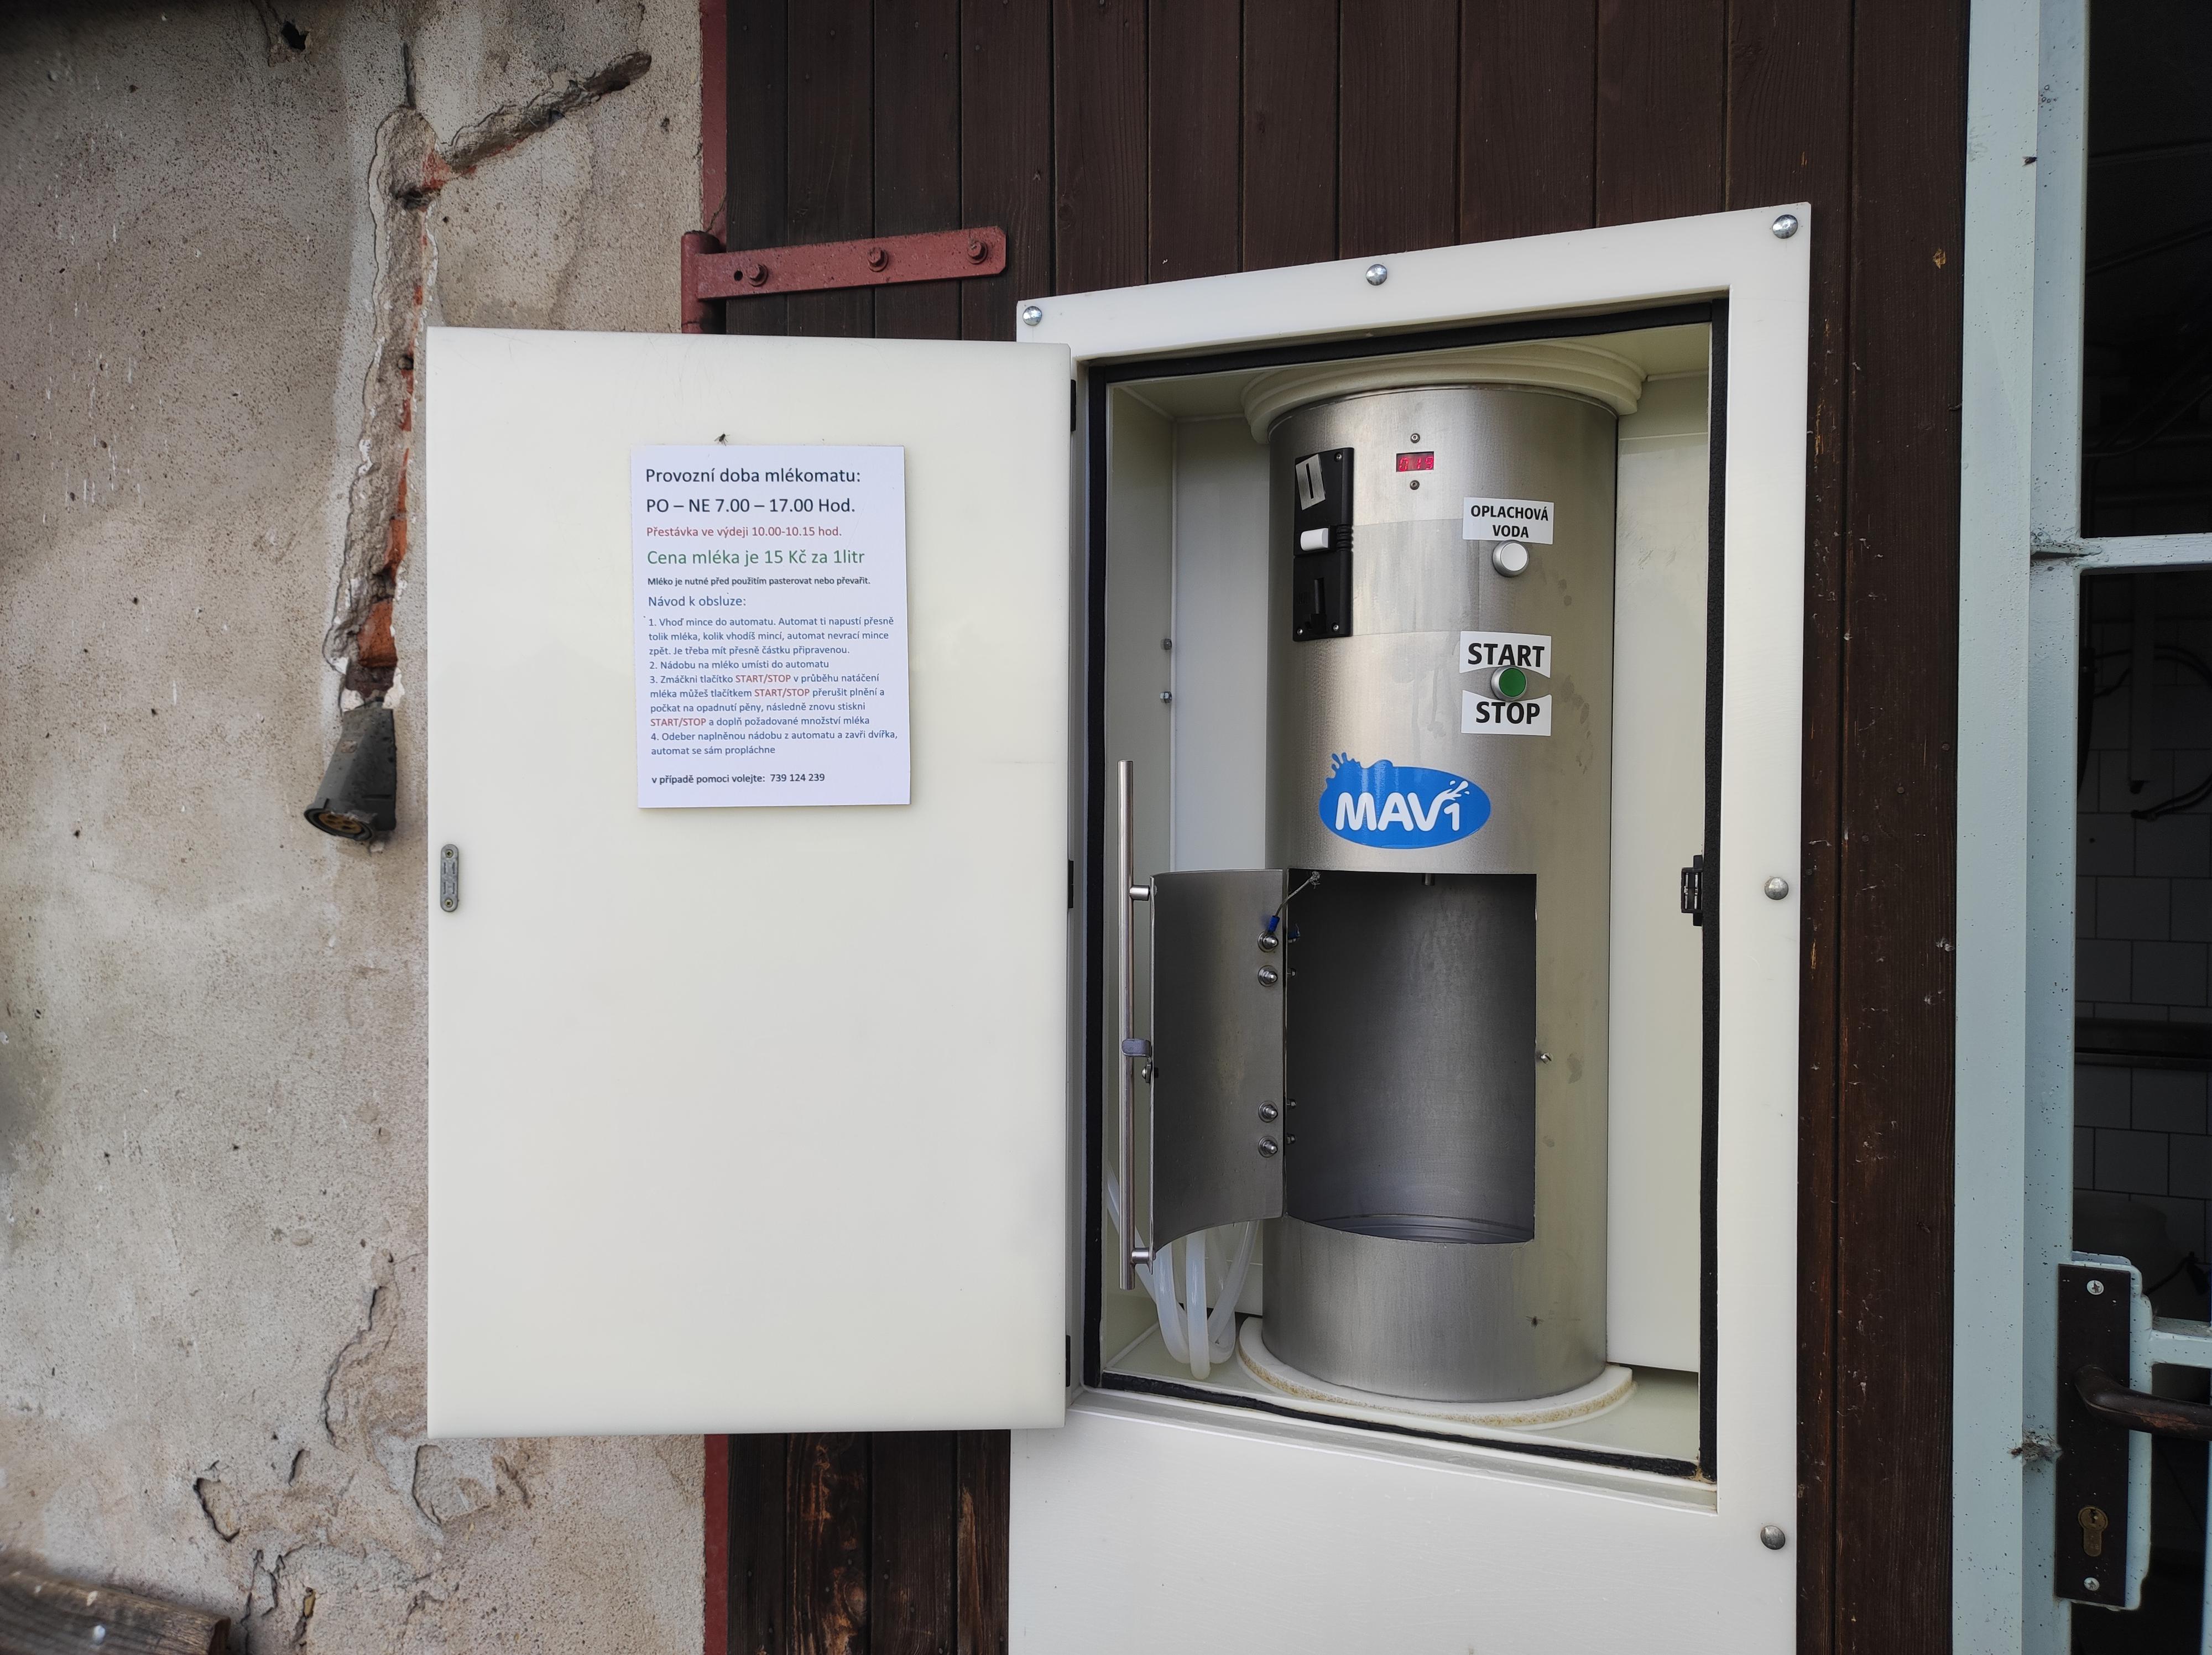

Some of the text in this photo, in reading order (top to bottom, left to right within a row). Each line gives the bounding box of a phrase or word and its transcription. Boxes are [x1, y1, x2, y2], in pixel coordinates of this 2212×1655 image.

[646, 467, 860, 483] Provozní doba mlékomatu:
[646, 498, 669, 513] PO
[688, 498, 711, 513] NE
[714, 498, 750, 513] 7.00
[769, 498, 814, 513] 17.00
[818, 497, 855, 513] Hod.
[1470, 505, 1549, 521] OPLACHOVÁ
[646, 525, 843, 539] Přestávka ve výdeji 10.00-10.15 hod.
[1492, 524, 1530, 538] VODA
[647, 549, 865, 567] Cena mléka je 15 Kč za 1litr
[647, 576, 871, 587] Mléko je nutné před použitím pasterovat nebo převařit.
[648, 595, 746, 607] Návod k obsluze:
[648, 616, 894, 628] 1. Vhoď mince do automatu. Automat ti napustí přesně
[648, 632, 669, 641] tolik
[670, 631, 701, 642] mléka,
[703, 631, 724, 640] kolik
[726, 631, 756, 640] vhodíš
[758, 631, 785, 641] mincí,
[827, 630, 860, 640] nevrací
[862, 630, 889, 640] mince
[649, 645, 850, 657] zpět. Je třeba mít přesně částku připravenou.
[1468, 643, 1545, 668] START
[649, 661, 658, 670] 2.
[660, 660, 696, 670] Nádobu
[711, 660, 739, 669] mléko
[741, 660, 769, 669] umísti
[771, 659, 784, 669] do
[785, 660, 830, 669] automatu
[649, 675, 659, 684] 3.
[660, 675, 698, 684] Zmáčkni
[699, 674, 734, 683] tlačítko
[734, 674, 791, 684] START/STOP
[800, 673, 839, 685] průběhu
[841, 673, 880, 683] natáčení
[650, 689, 677, 698] mléka
[679, 688, 709, 698] můžeš
[709, 688, 753, 698] tlačítkem
[754, 688, 810, 698] START/STOP
[812, 687, 848, 698] přerušit
[849, 687, 878, 698] plnění
[650, 703, 681, 714] počkat
[696, 702, 737, 714] opadnutí
[739, 702, 764, 713] pěny,
[766, 702, 807, 712] následně
[837, 701, 865, 711] stiskni
[1475, 701, 1541, 724] STOP
[650, 717, 707, 728] START/STOP
[716, 717, 742, 728] doplň
[744, 716, 799, 728] požadované
[801, 716, 841, 725] množství
[843, 716, 870, 725] mléka
[650, 733, 660, 741] 4.
[661, 731, 696, 741] Odeber
[697, 731, 746, 743] naplněnou
[748, 730, 782, 740] nádobu
[791, 731, 835, 739] automatu
[844, 729, 866, 739] zavři
[868, 729, 898, 740] dvířka,
[651, 747, 690, 755] automat
[703, 745, 723, 755] sám
[724, 745, 776, 756] propláchne
[659, 774, 695, 786] případě
[696, 774, 730, 785] pomoci
[731, 774, 765, 785] volejte:
[769, 774, 787, 782] 739
[789, 773, 807, 782] 124
[808, 773, 825, 782] 239
